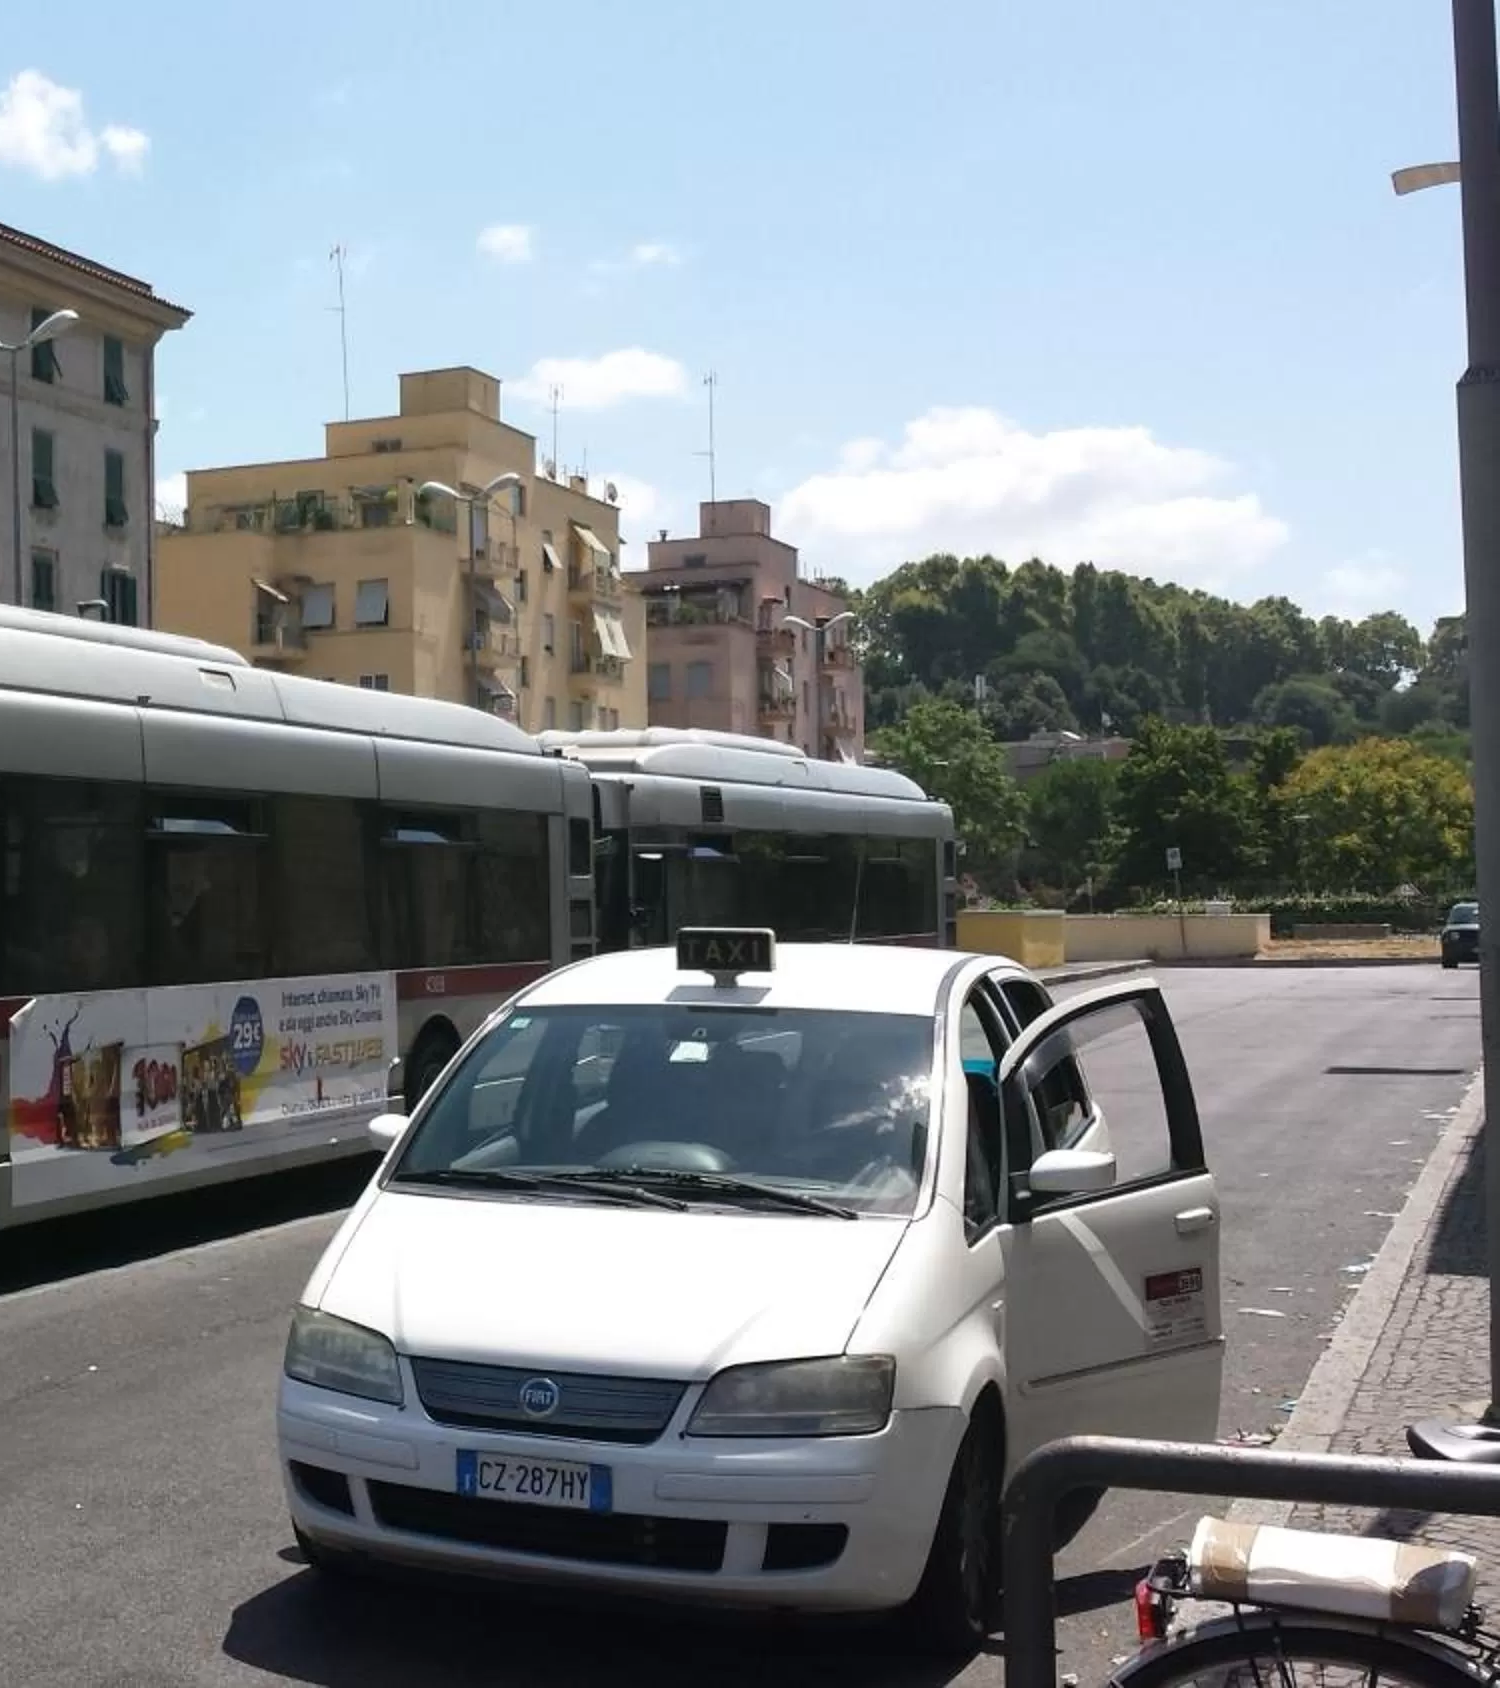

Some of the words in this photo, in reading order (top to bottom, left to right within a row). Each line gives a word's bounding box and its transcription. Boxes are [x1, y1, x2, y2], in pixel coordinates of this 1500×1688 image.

[683, 939, 761, 963] TAXI
[280, 1038, 307, 1077] sky
[525, 1388, 553, 1405] FIAT
